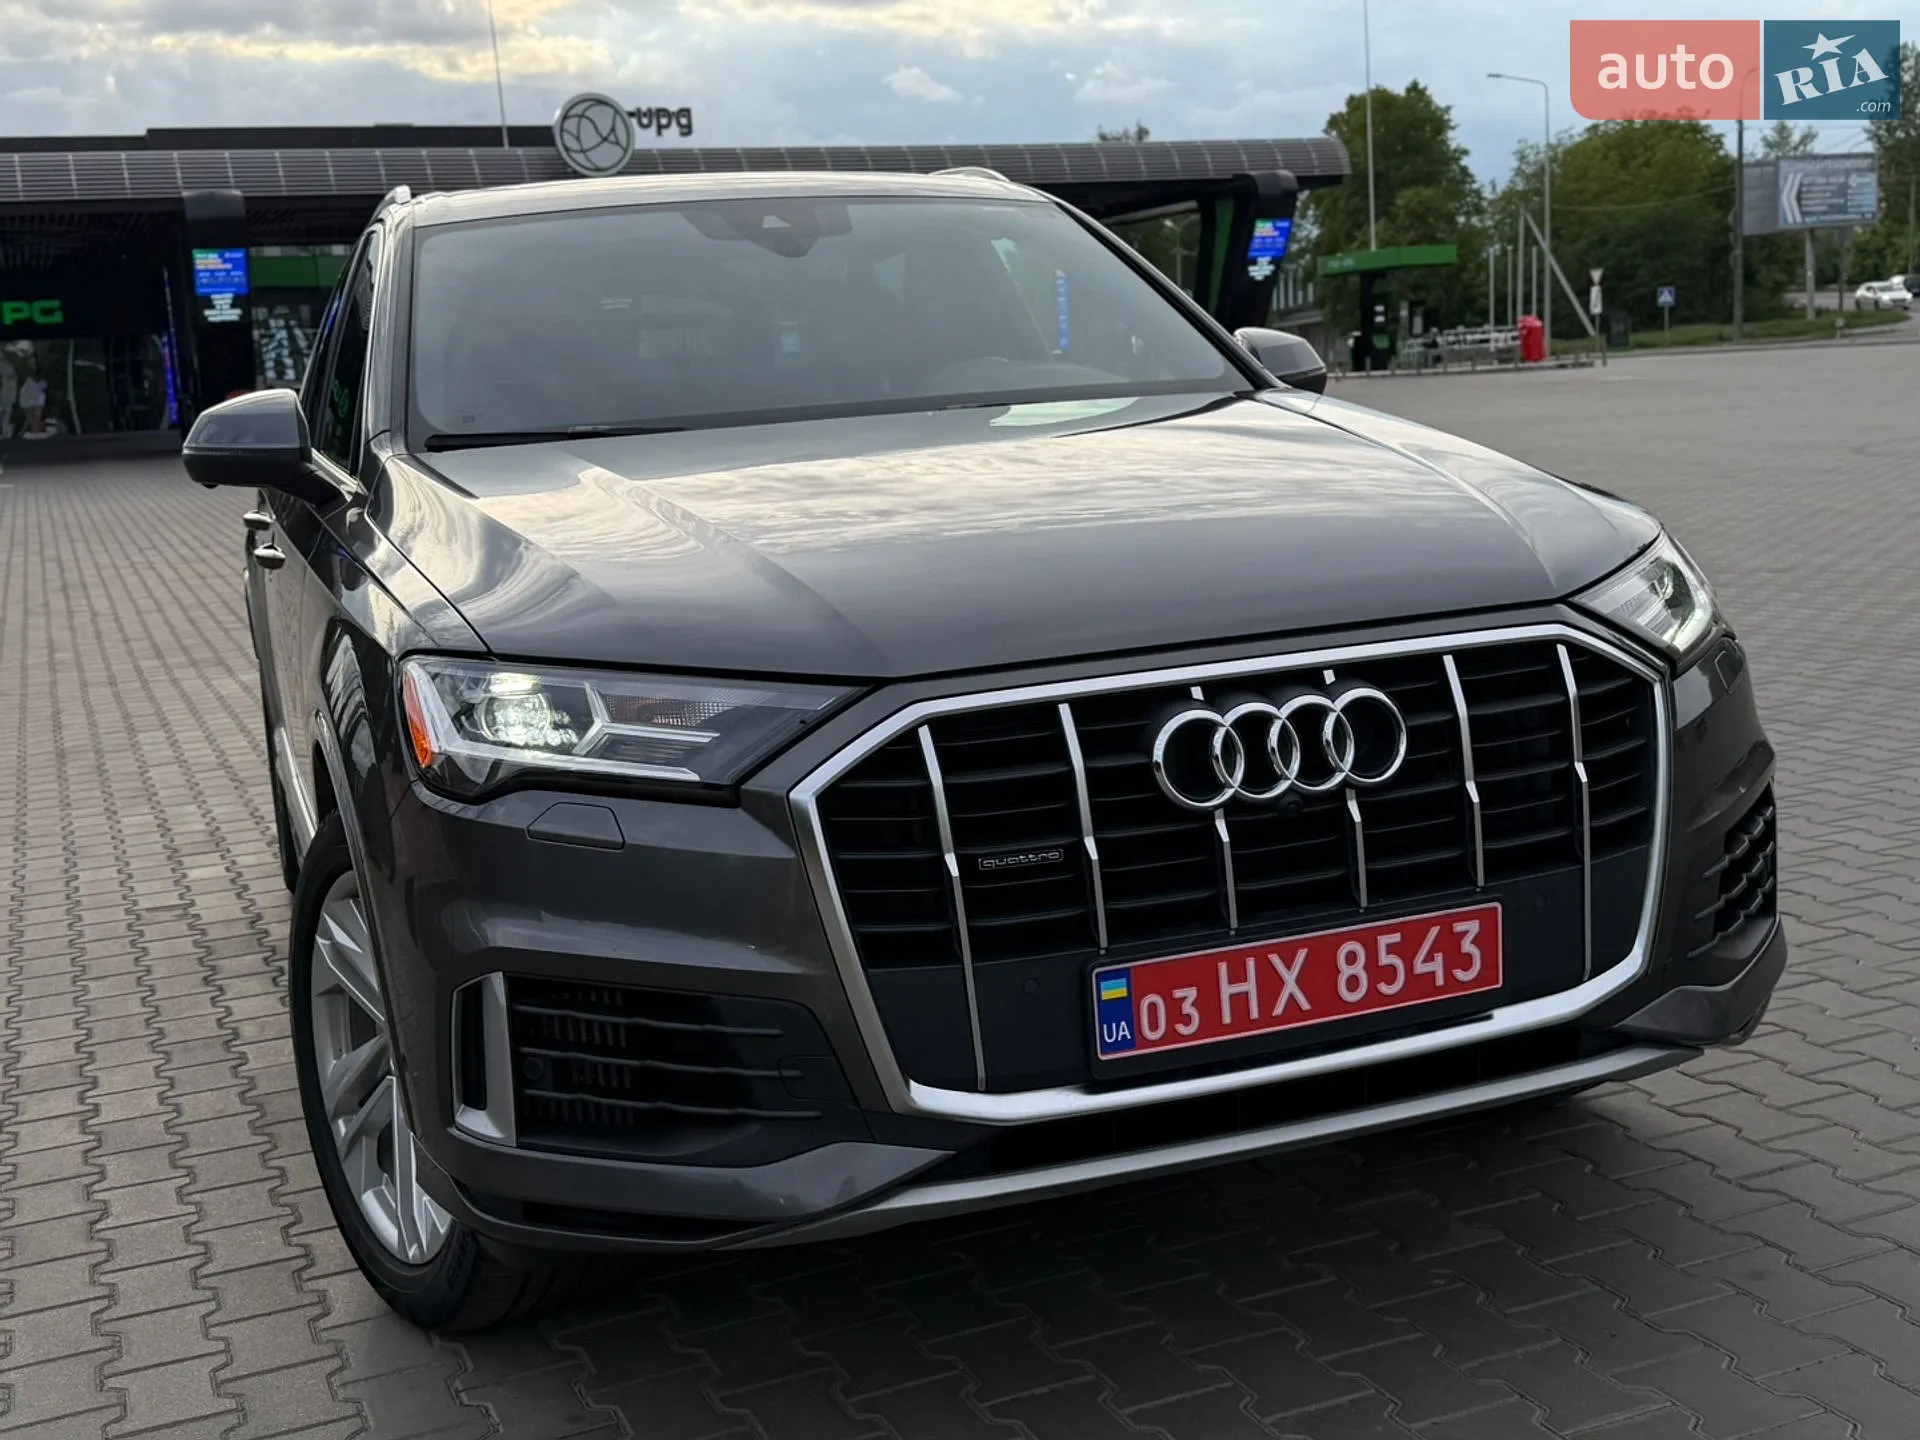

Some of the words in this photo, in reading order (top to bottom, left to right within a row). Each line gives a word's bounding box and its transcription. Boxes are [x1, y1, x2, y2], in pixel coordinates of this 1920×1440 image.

[635, 107, 693, 137] upg
[982, 851, 1061, 869] quattro
[1139, 986, 1200, 1041] 03
[1217, 948, 1311, 1024] HX
[1336, 919, 1482, 1003] 8543
[1103, 1021, 1132, 1043] UA
